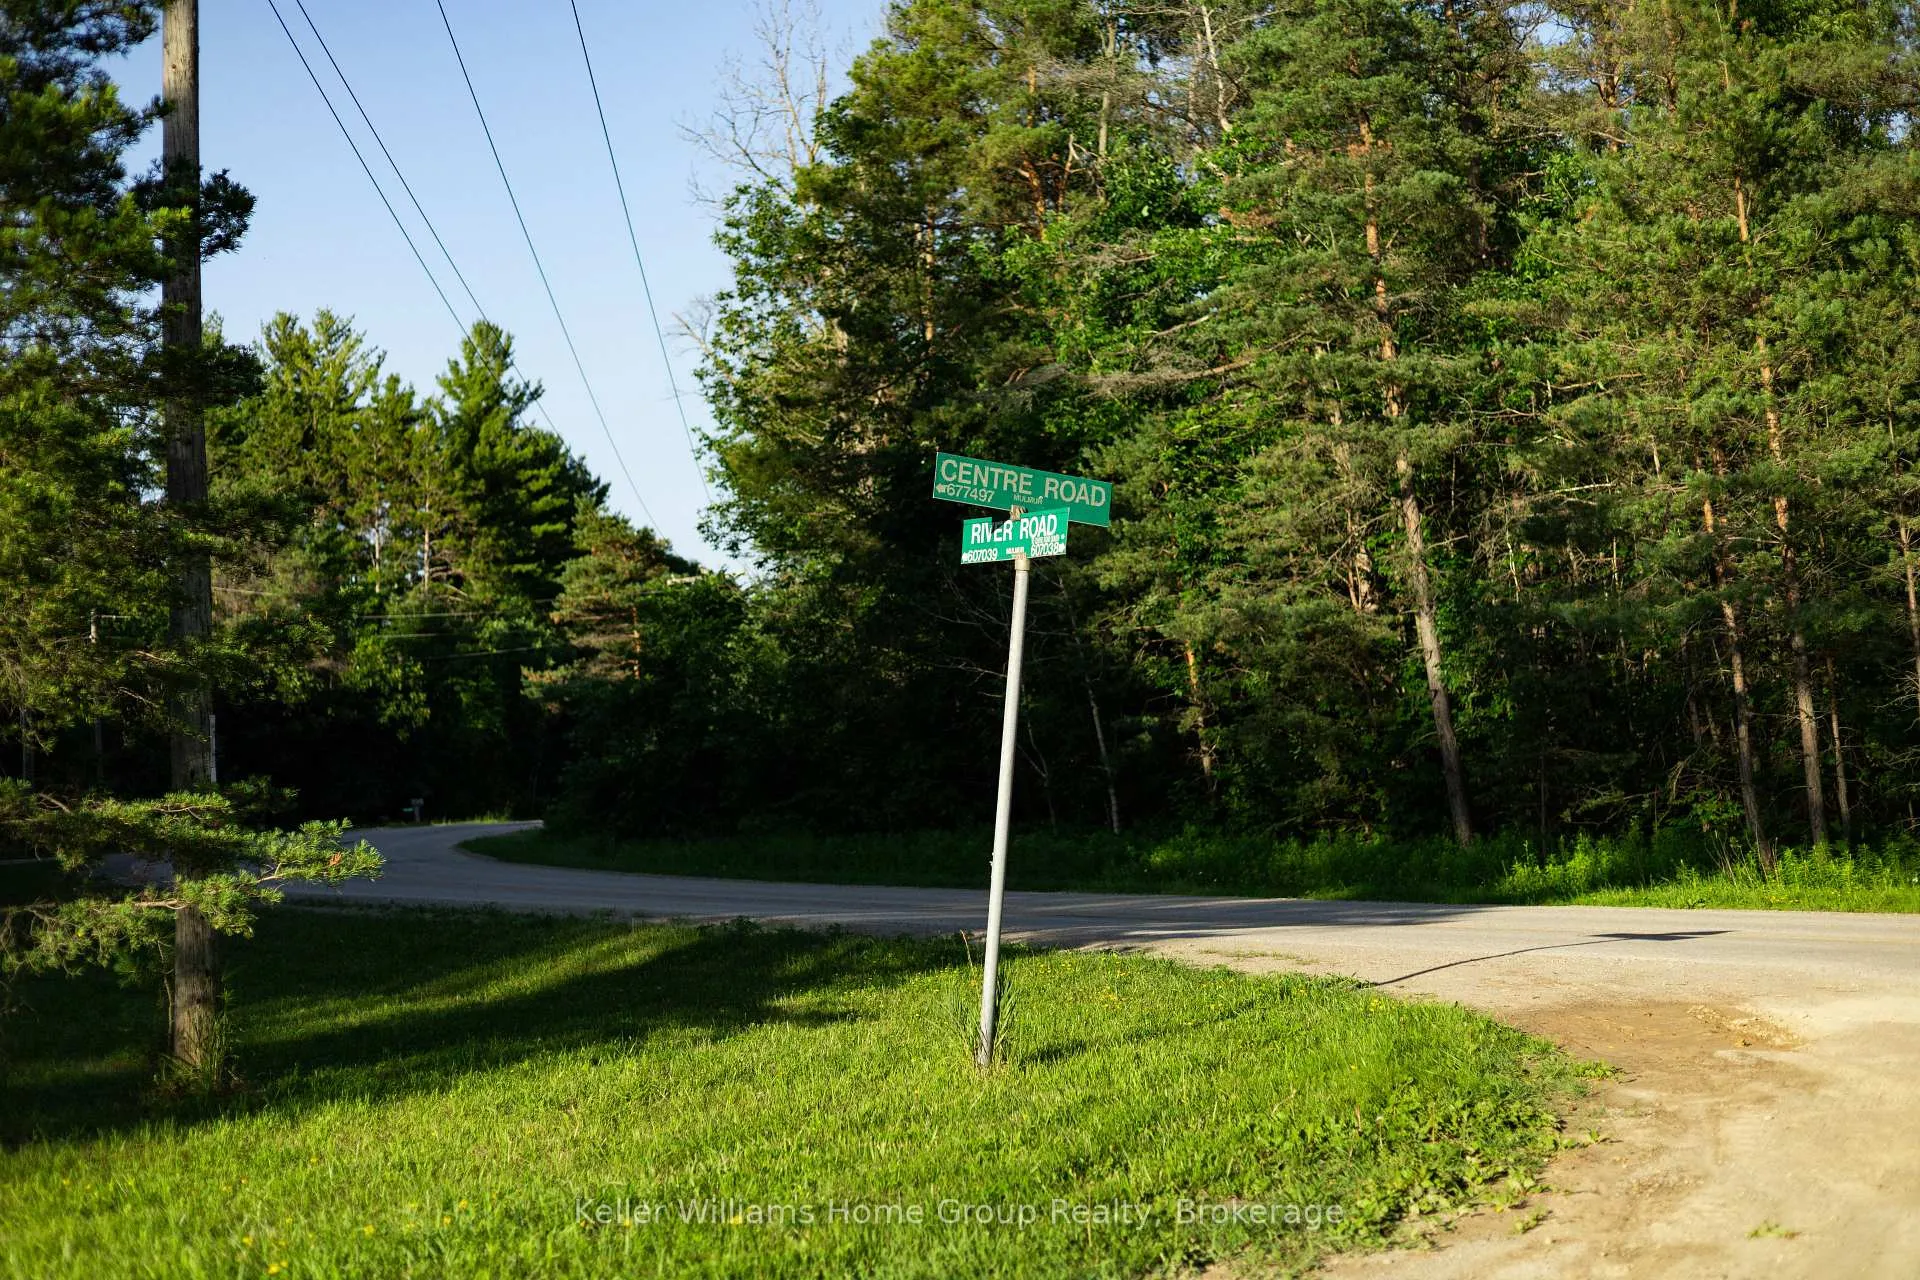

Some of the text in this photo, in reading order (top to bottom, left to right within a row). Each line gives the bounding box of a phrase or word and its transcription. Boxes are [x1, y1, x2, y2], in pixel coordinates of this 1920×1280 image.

[941, 459, 1106, 507] CENTRE ROAD
[946, 483, 995, 502] 677497
[970, 514, 1058, 545] RIVER ROAD
